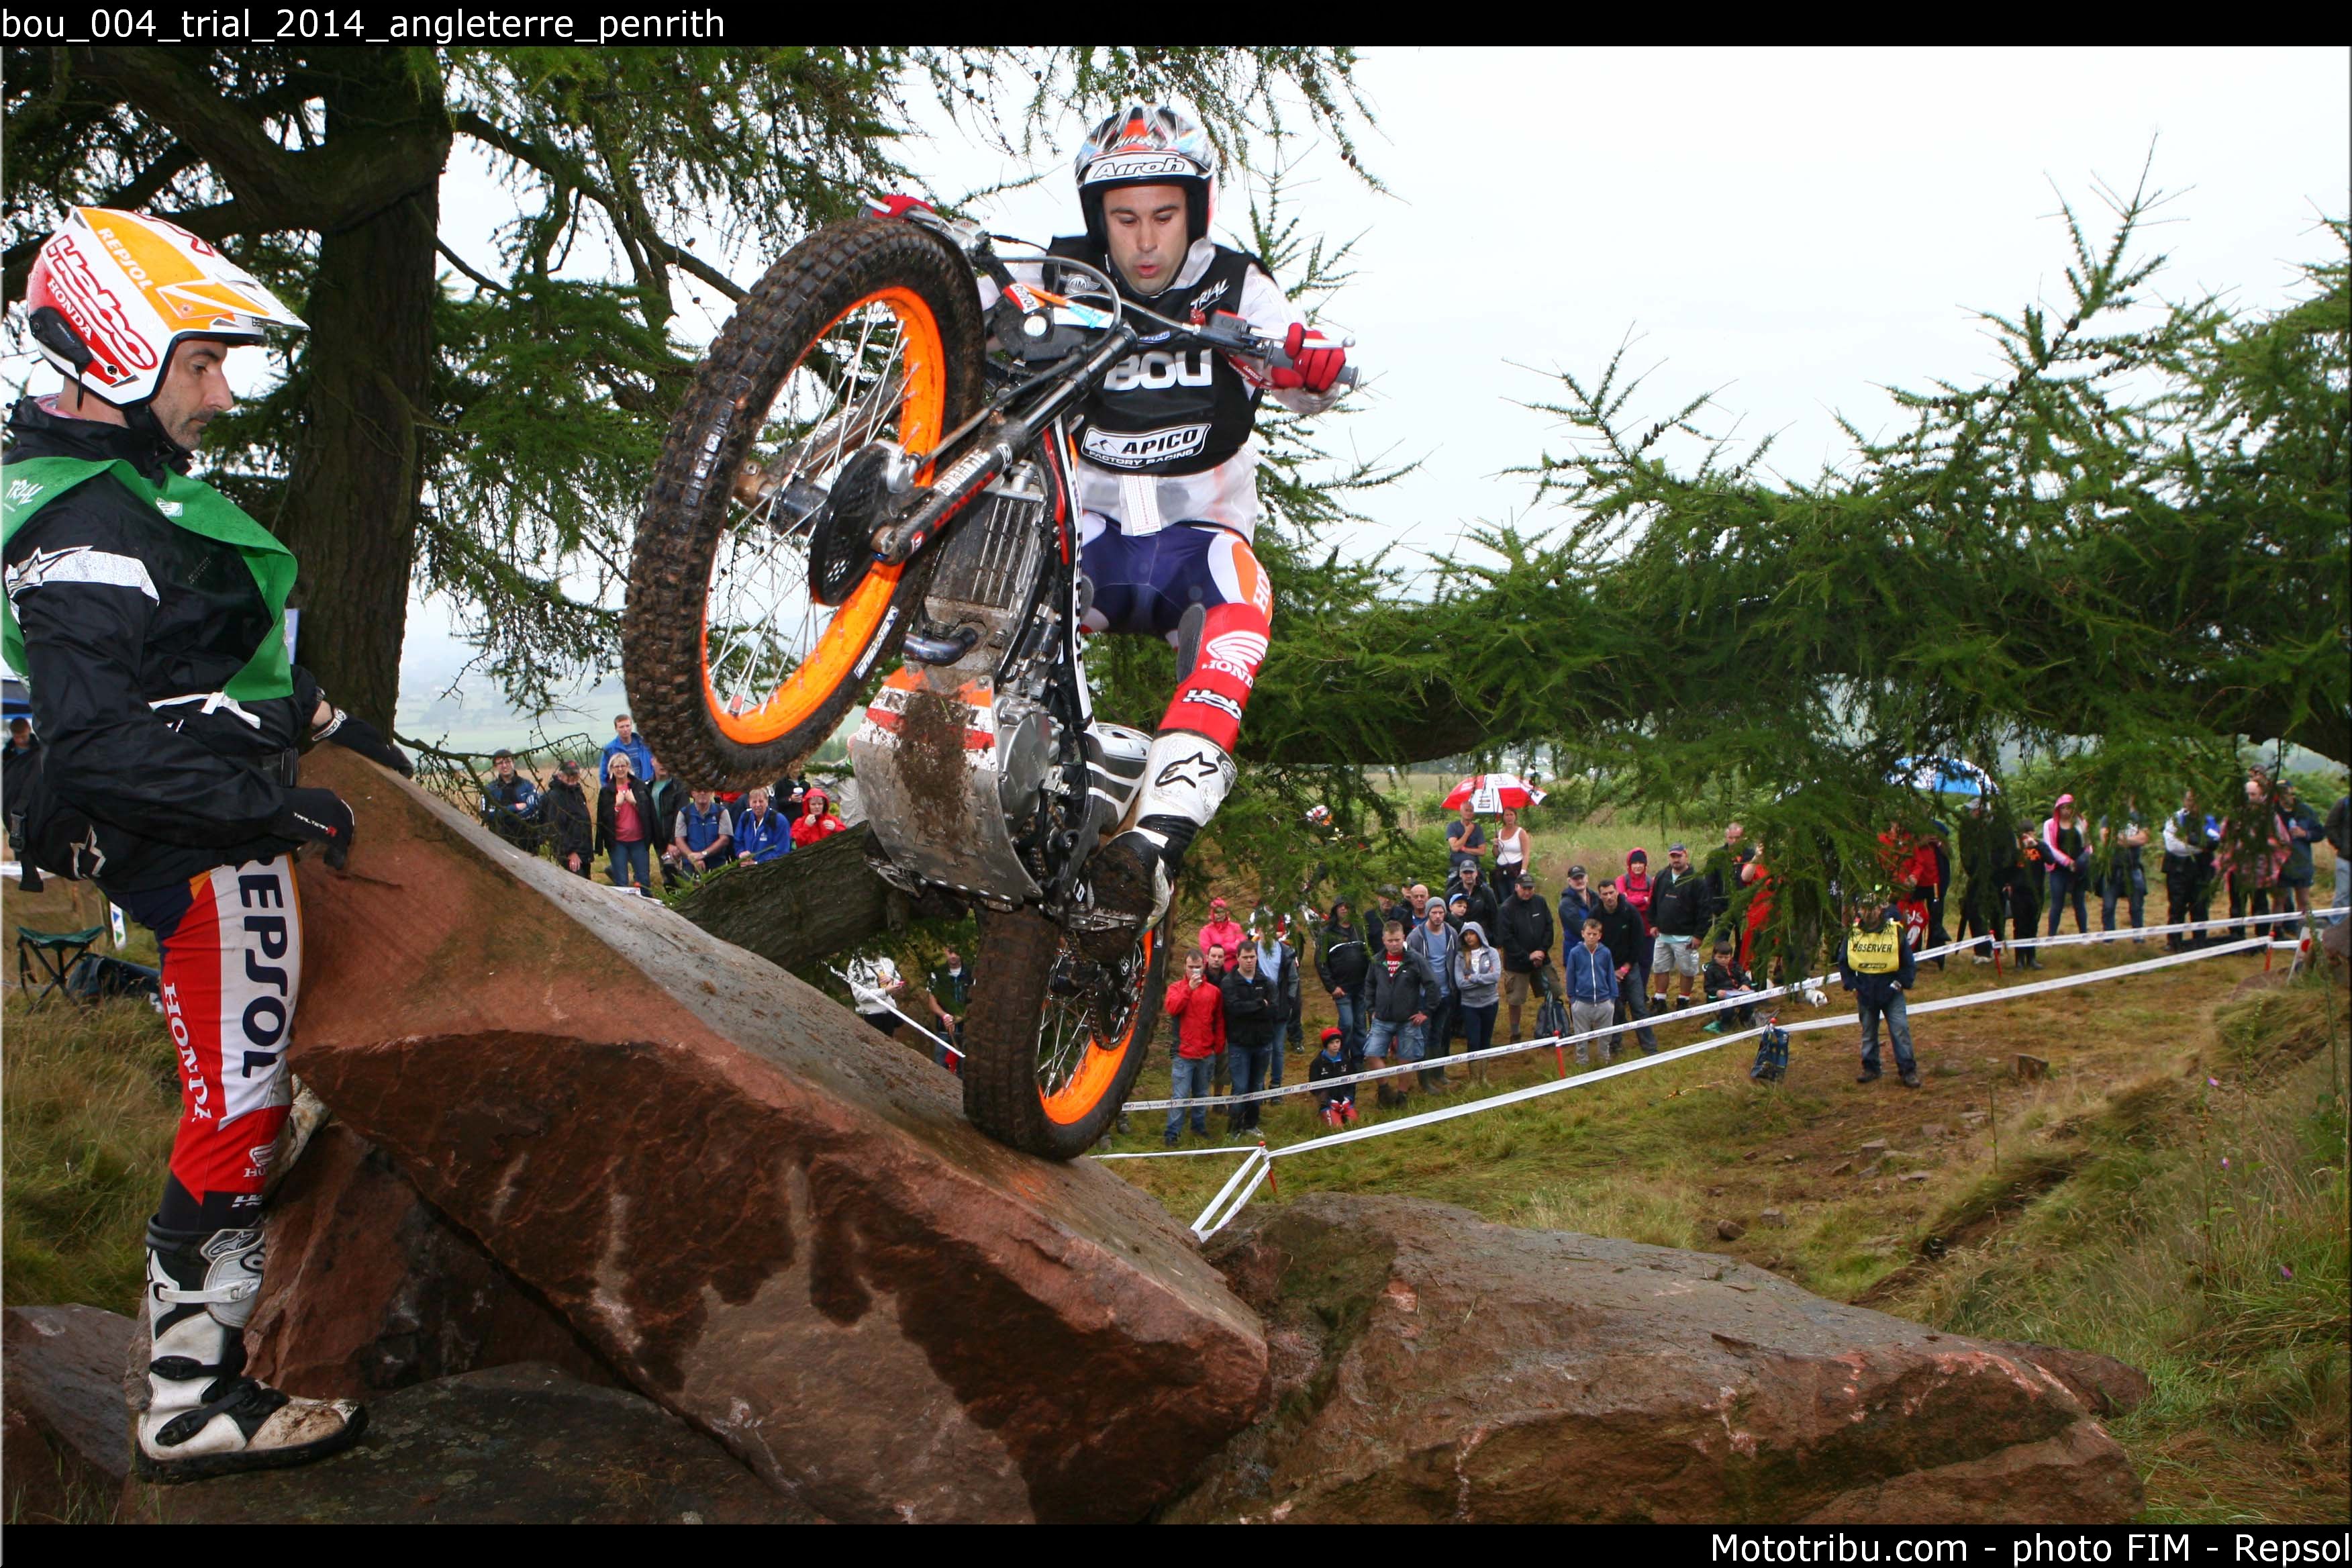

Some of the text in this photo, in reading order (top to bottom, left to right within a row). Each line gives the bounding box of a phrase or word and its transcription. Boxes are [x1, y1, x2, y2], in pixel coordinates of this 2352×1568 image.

[97, 227, 154, 291] REPSOL
[46, 279, 92, 341] HONDA
[1190, 278, 1230, 310] TRIAL
[1103, 348, 1213, 391] BOU
[1088, 449, 1195, 466] FACTORY RACING
[1121, 428, 1199, 455] APICO
[235, 854, 289, 1079] EPSOL
